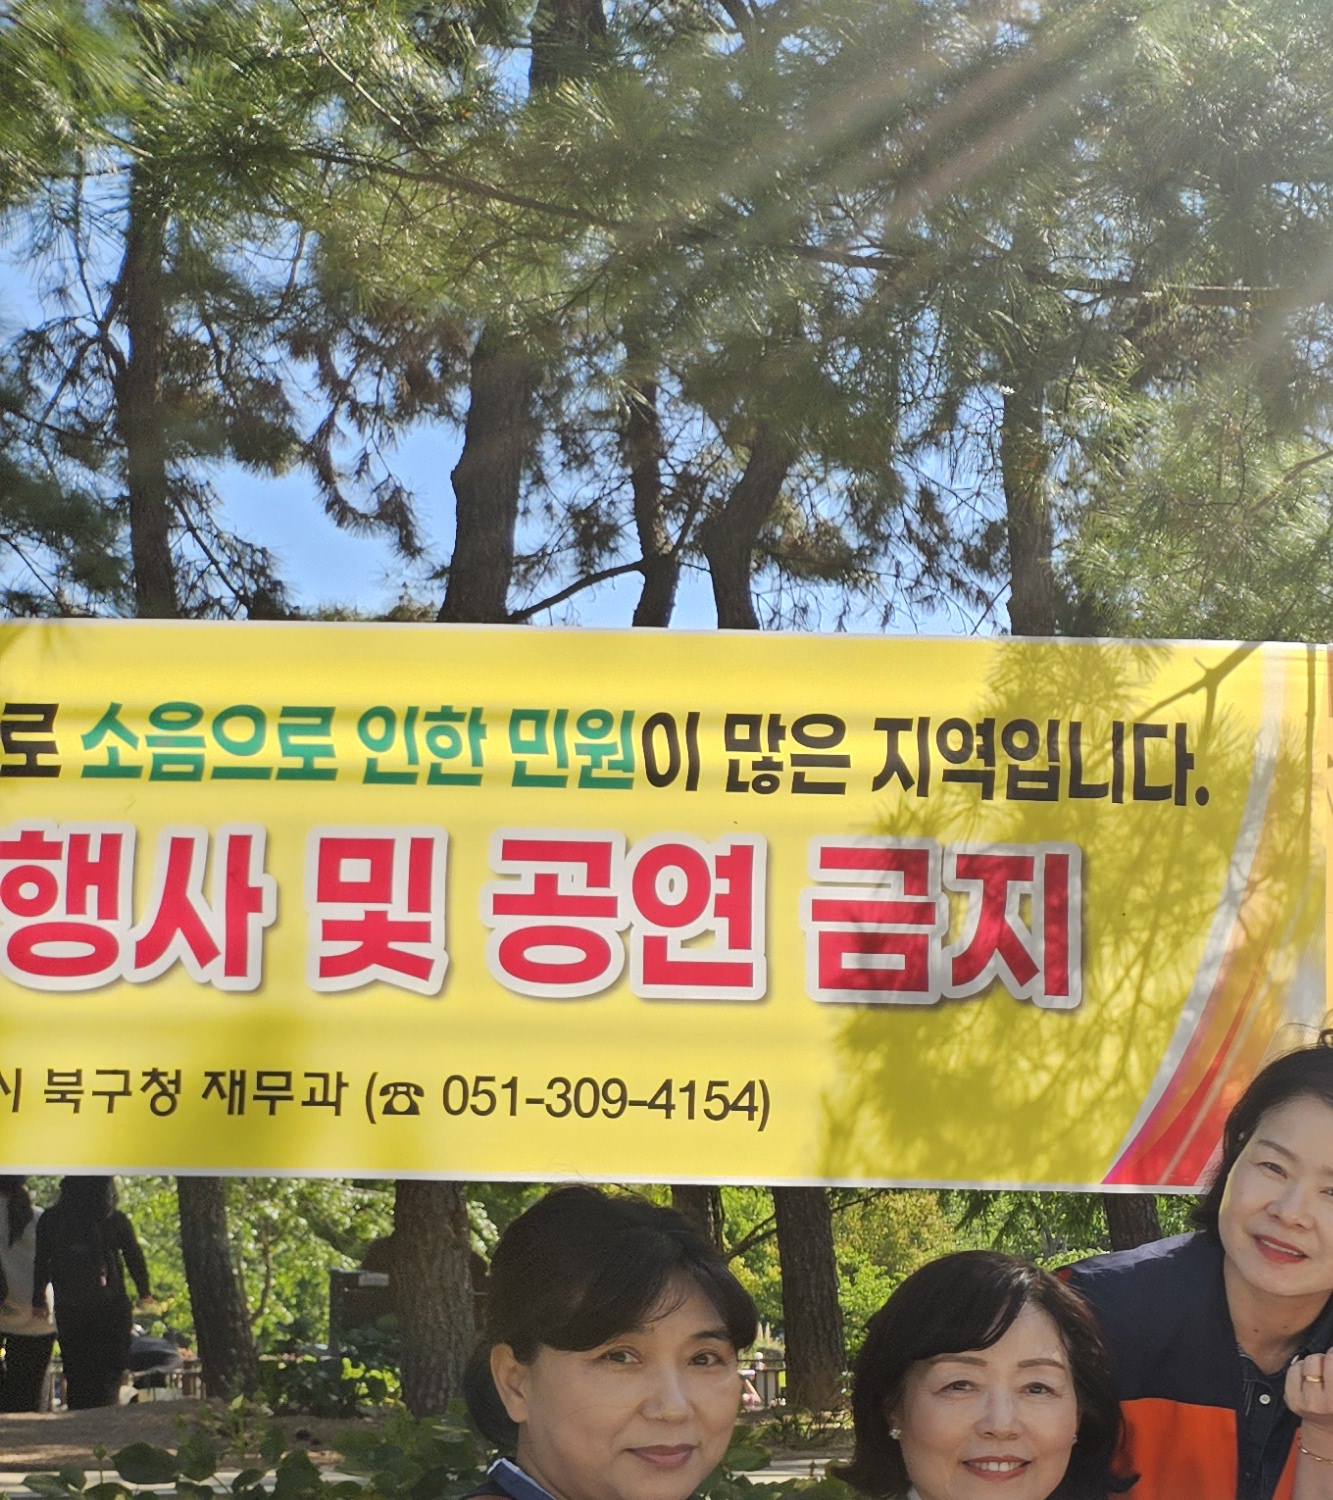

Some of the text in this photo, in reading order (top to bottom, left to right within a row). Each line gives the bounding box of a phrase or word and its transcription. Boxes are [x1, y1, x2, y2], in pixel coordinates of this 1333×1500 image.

[0, 702, 1210, 806] 로 소음으로 인한 민원이 많은 지역입니다.
[0, 828, 1071, 998] 행사 및 공연 금지
[44, 1067, 182, 1118] 북구청
[201, 1068, 349, 1118] 재무과
[443, 1075, 773, 1131] 051-309-4154)
